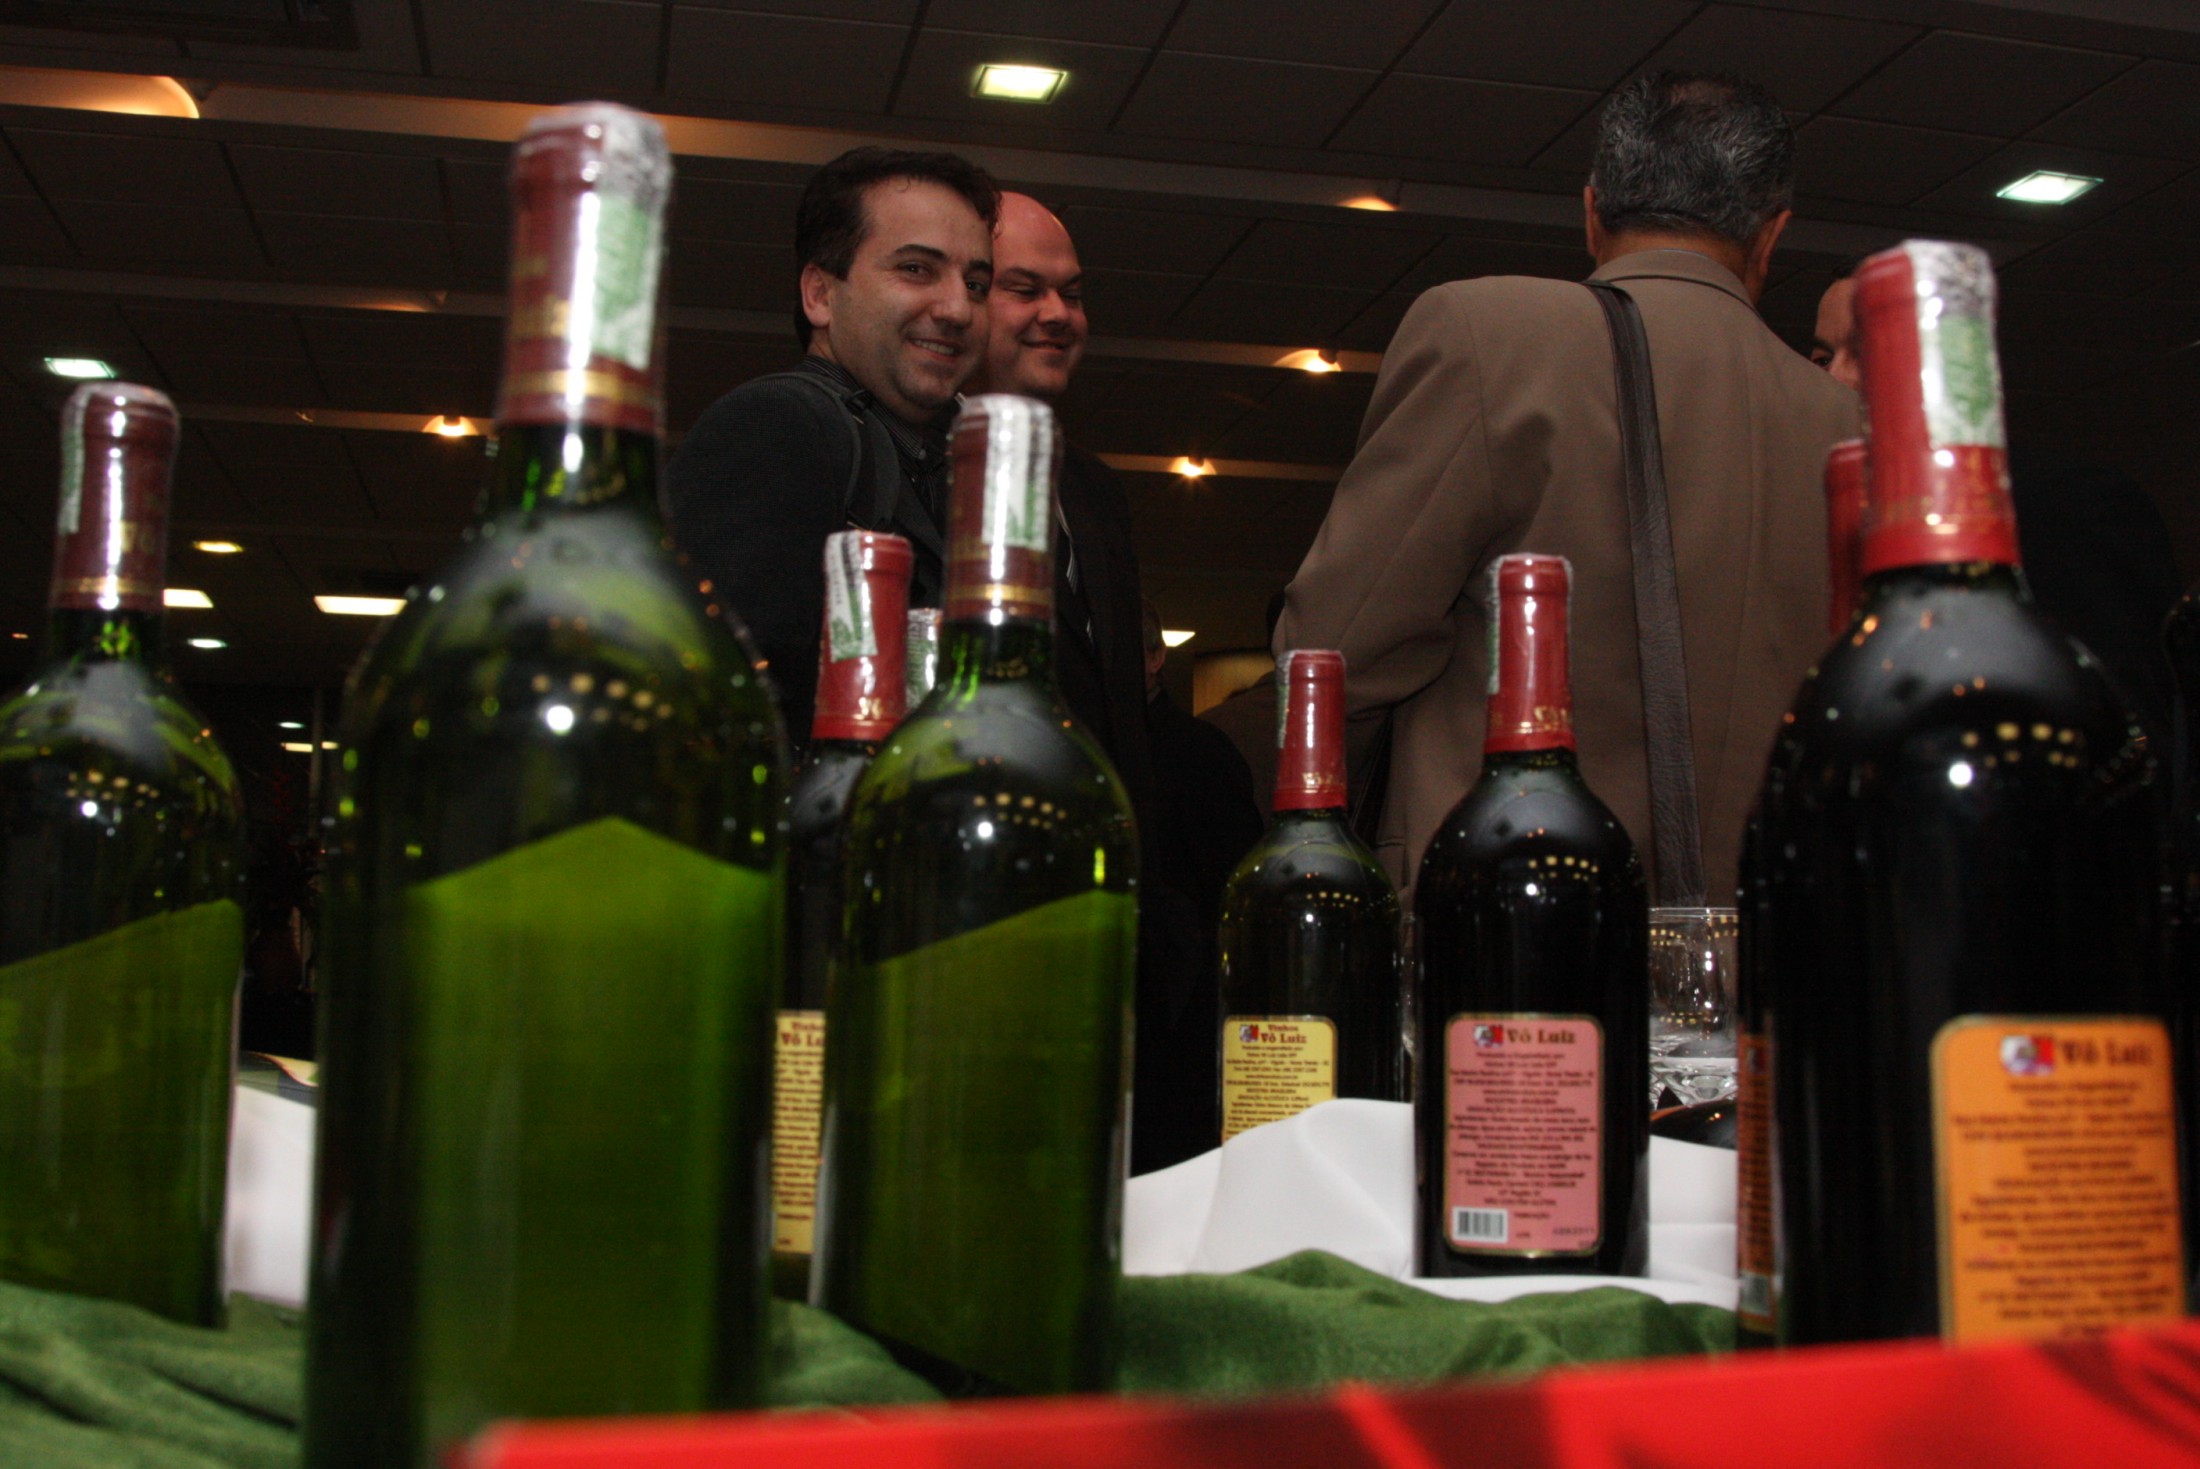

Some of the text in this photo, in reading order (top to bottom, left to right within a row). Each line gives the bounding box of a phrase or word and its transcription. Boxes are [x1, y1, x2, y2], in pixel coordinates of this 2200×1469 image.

[1261, 1033, 1307, 1044] Vô Luiz
[1506, 1028, 1576, 1044] Vô Luiz
[2105, 1040, 2153, 1067] Luiz
